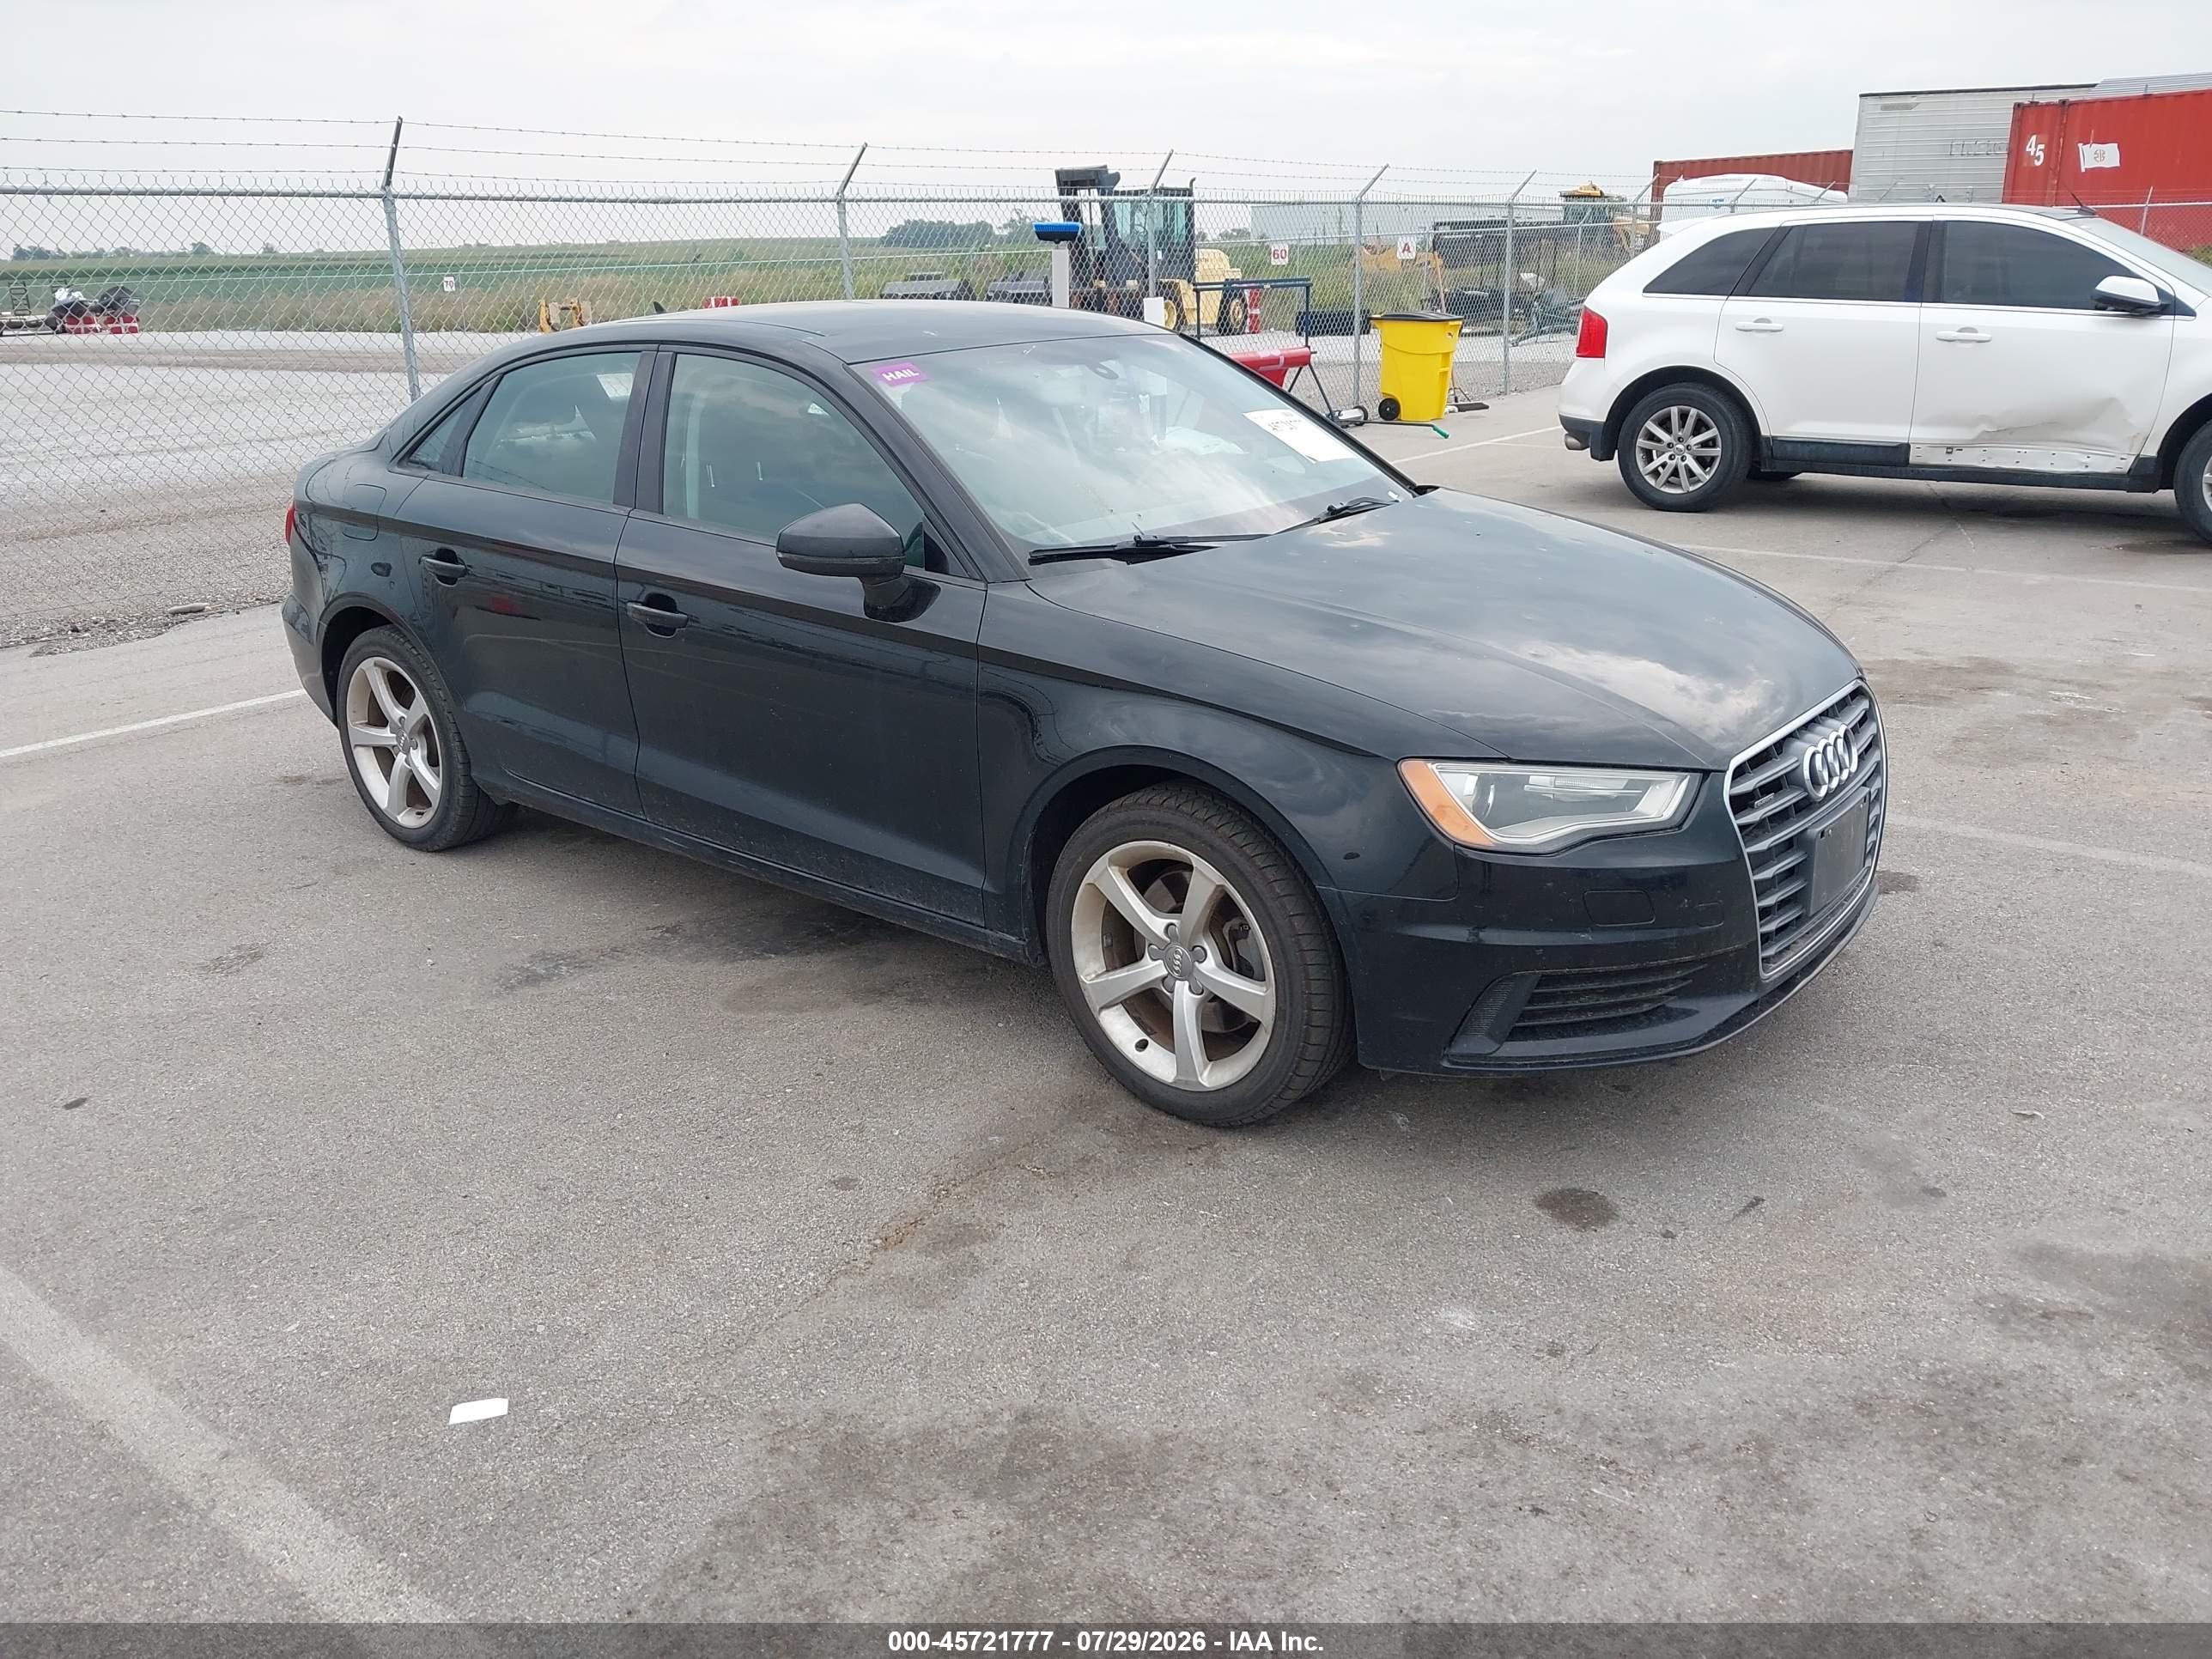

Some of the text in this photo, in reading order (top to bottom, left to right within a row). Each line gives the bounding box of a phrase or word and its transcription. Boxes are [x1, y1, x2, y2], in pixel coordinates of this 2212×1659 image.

[2026, 134, 2045, 167] 45
[1401, 242, 1413, 254] A
[1273, 249, 1287, 260] 60
[444, 280, 454, 289] 70
[882, 368, 920, 381] HAIL
